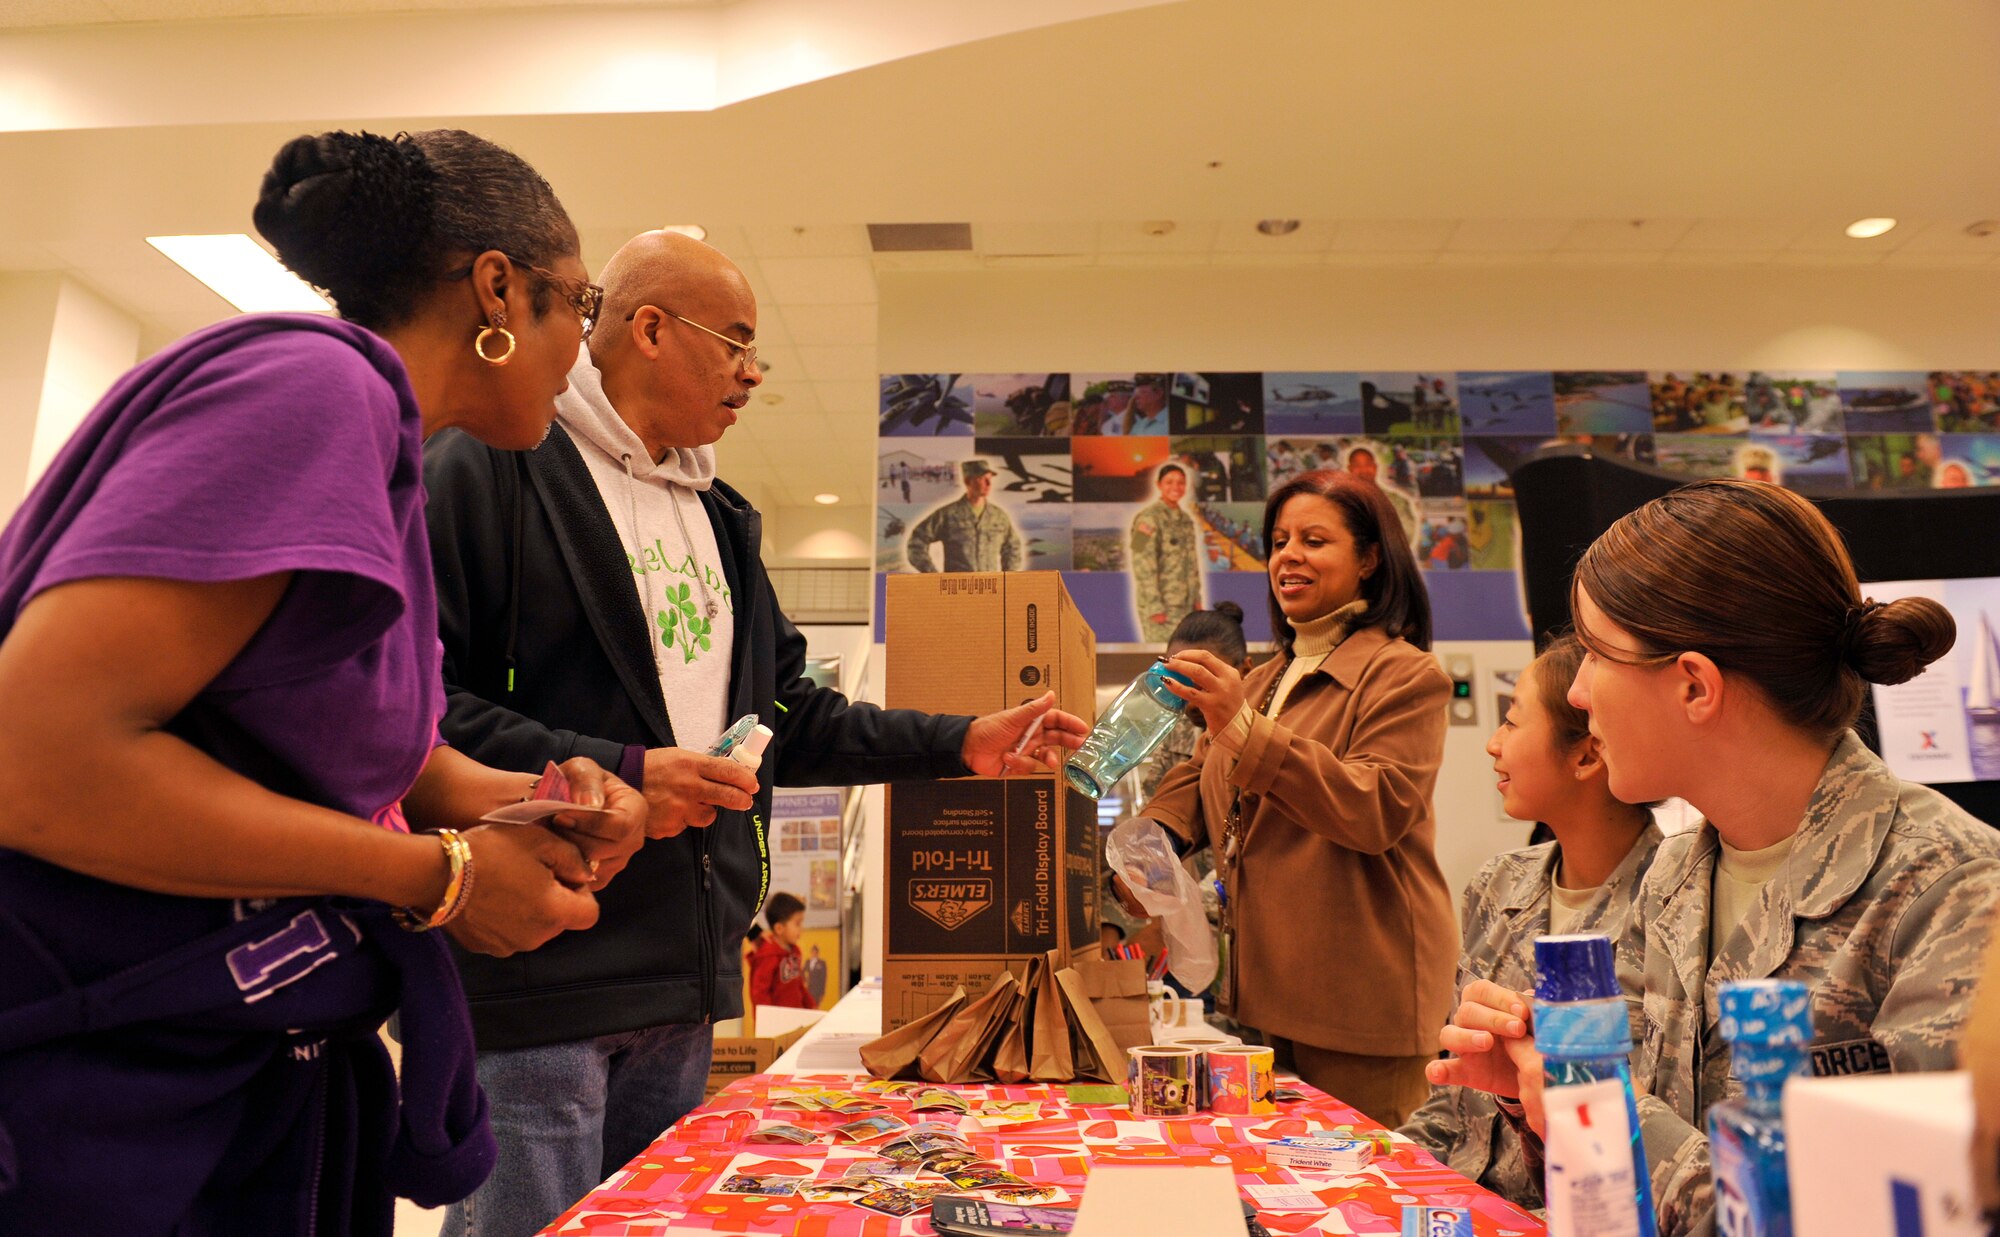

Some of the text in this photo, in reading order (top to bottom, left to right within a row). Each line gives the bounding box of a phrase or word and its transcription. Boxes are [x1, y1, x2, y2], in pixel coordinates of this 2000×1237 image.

[1028, 607, 1036, 650] WHITE INSIDE
[943, 809, 988, 817] Self Standing
[933, 820, 960, 828] surface
[753, 815, 767, 858] UNDER
[965, 829, 988, 837] Sturdy
[912, 850, 993, 872] Tri-Fold
[1035, 790, 1051, 936] Tri-Fold Display Board
[915, 884, 986, 899] ELMER'S
[728, 1045, 737, 1055] to
[739, 1045, 758, 1055] Life
[1811, 1041, 1890, 1076] ORCE
[1290, 1158, 1332, 1167] Trident White
